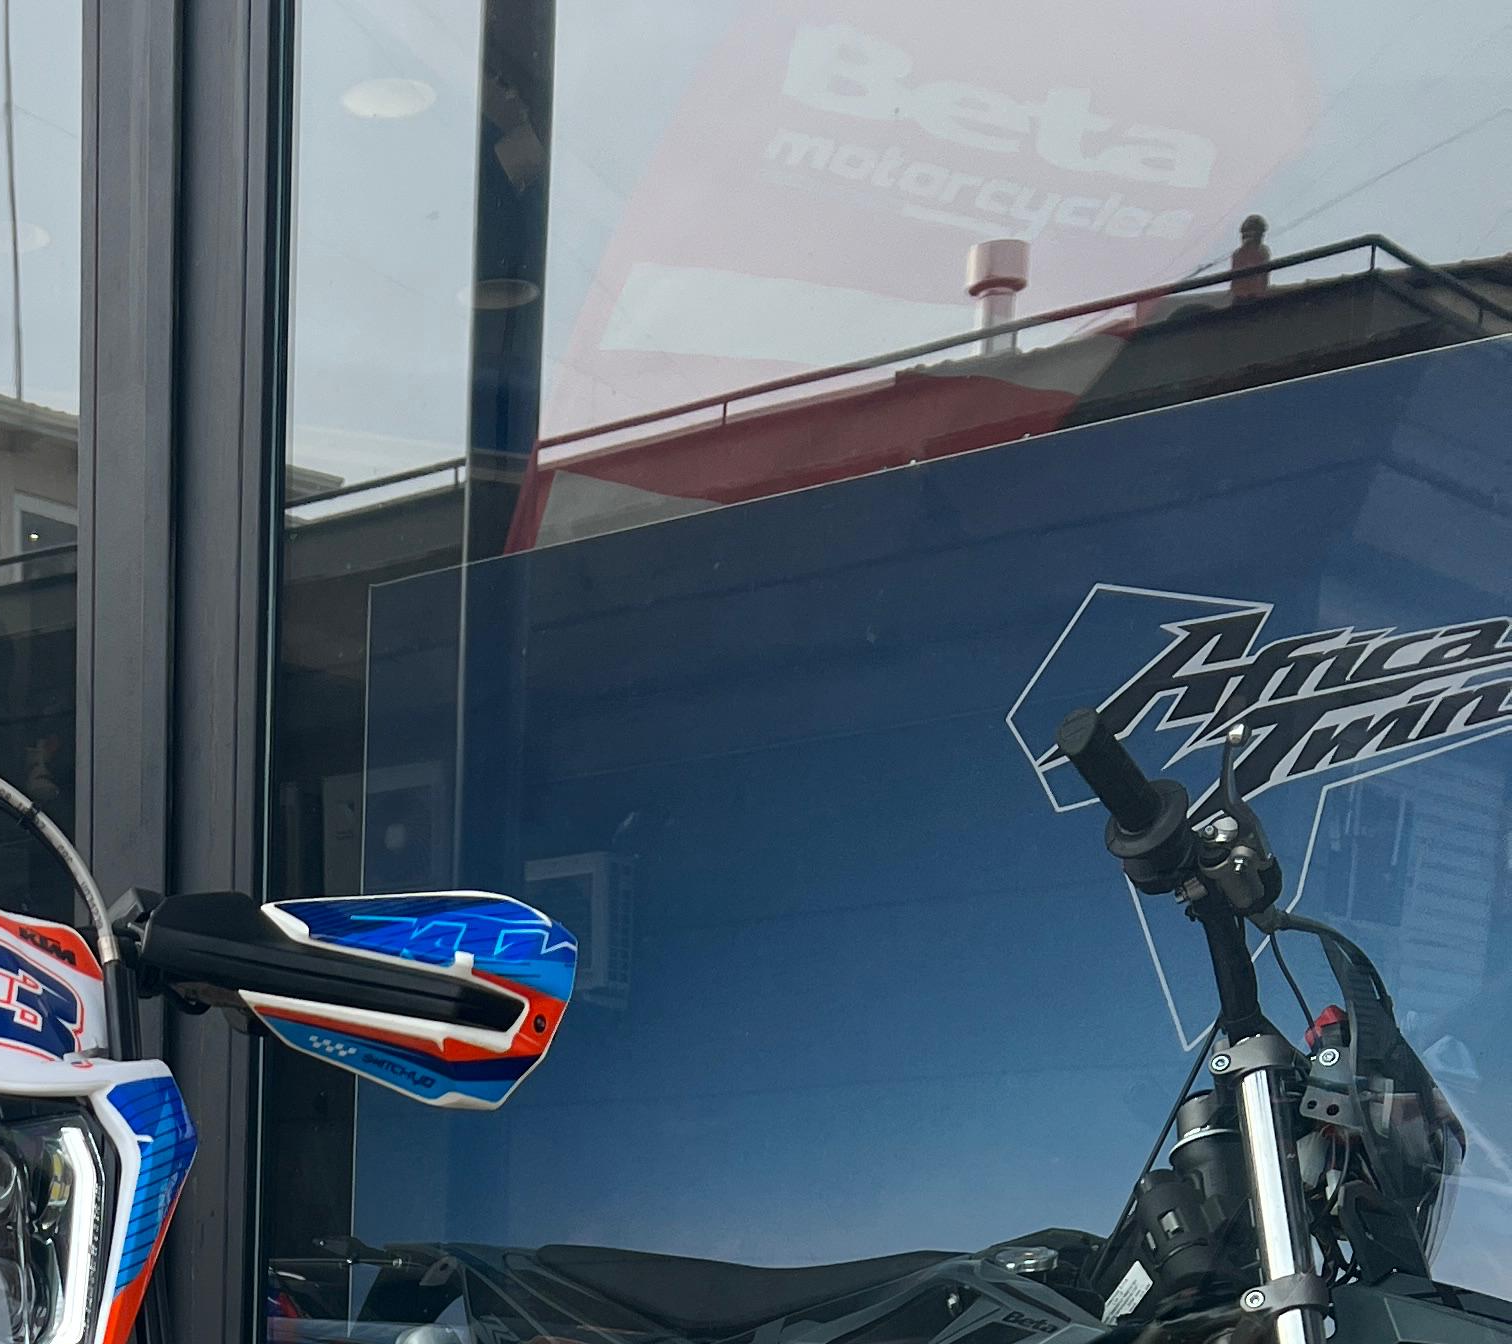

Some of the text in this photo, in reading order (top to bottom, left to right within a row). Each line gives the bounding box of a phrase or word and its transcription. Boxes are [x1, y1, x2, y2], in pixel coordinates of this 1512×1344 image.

[782, 24, 1217, 188] Beta
[764, 129, 1194, 241] motorcycles
[18, 926, 77, 966] KTM
[1003, 1311, 1059, 1334] Beta
